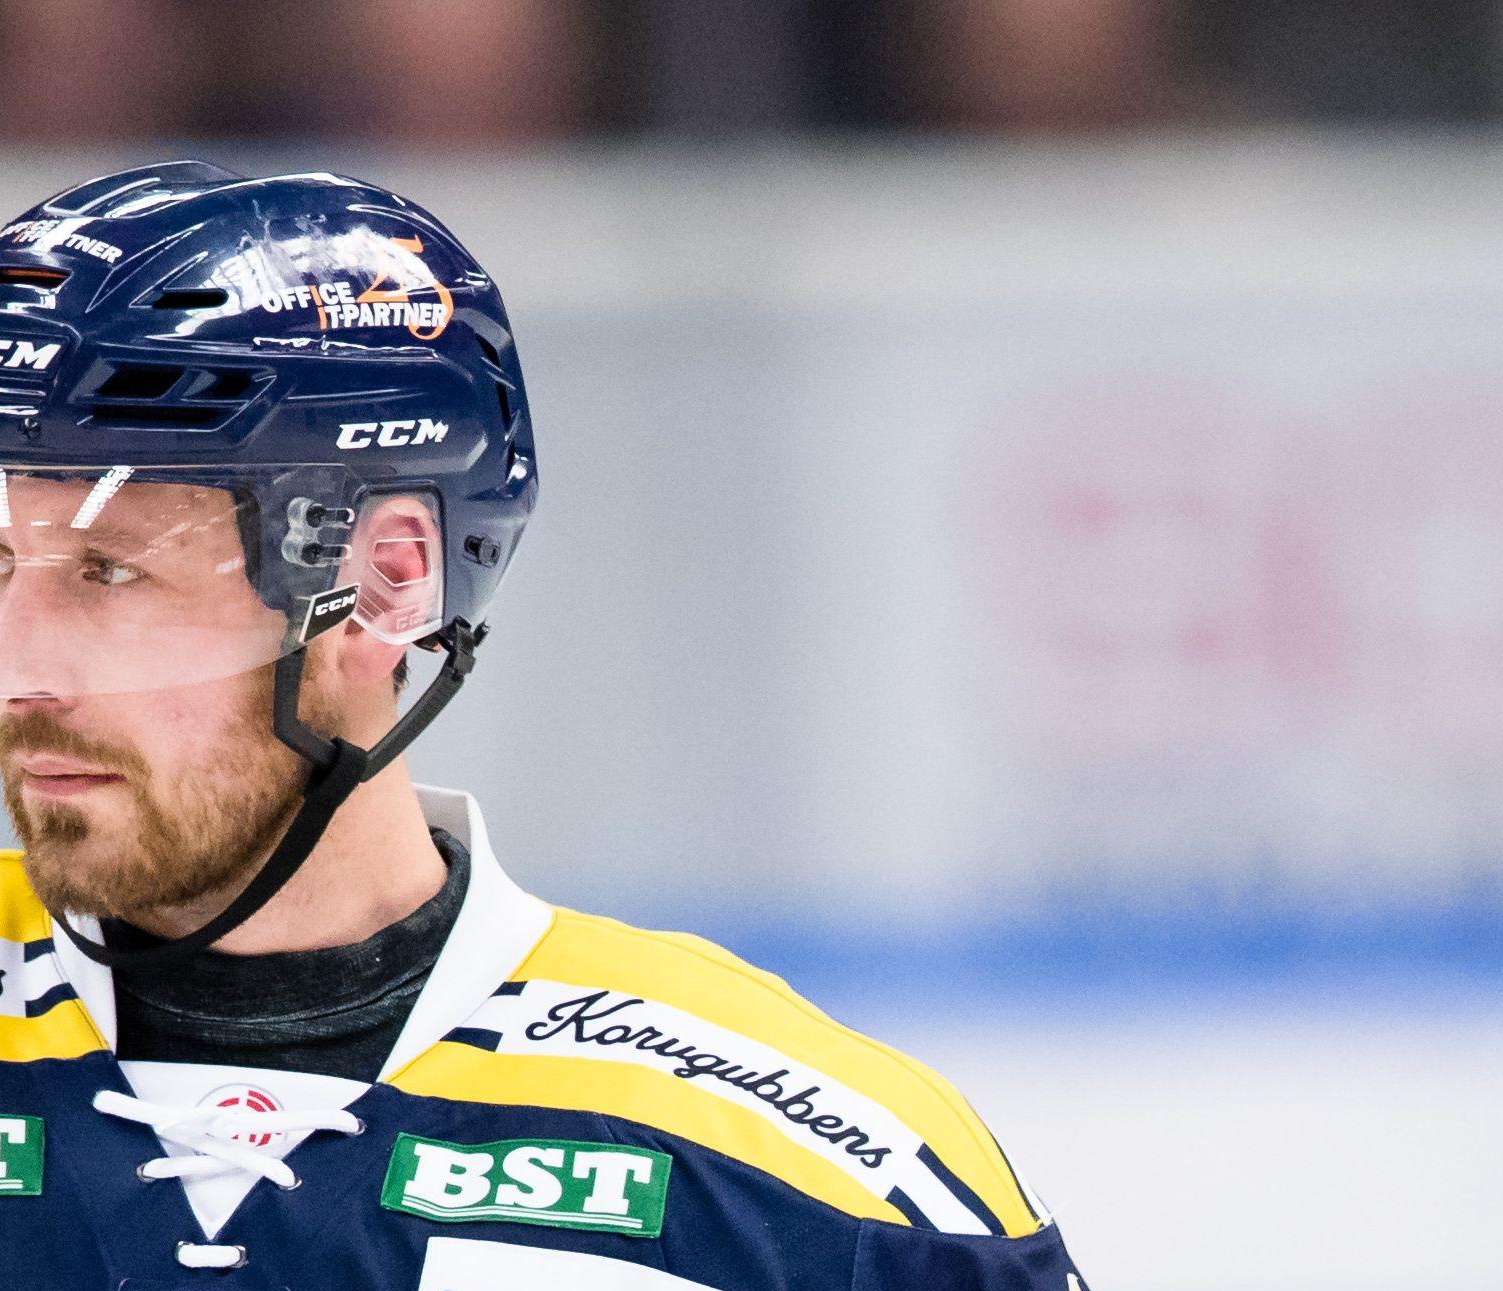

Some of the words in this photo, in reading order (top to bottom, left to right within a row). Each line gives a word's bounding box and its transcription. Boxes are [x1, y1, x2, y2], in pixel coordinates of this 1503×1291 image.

[261, 281, 355, 313] OFFICE
[336, 418, 449, 450] CCM
[314, 593, 357, 617] CCM
[525, 990, 892, 1169] Korvgubbens
[408, 1144, 653, 1217] BST
